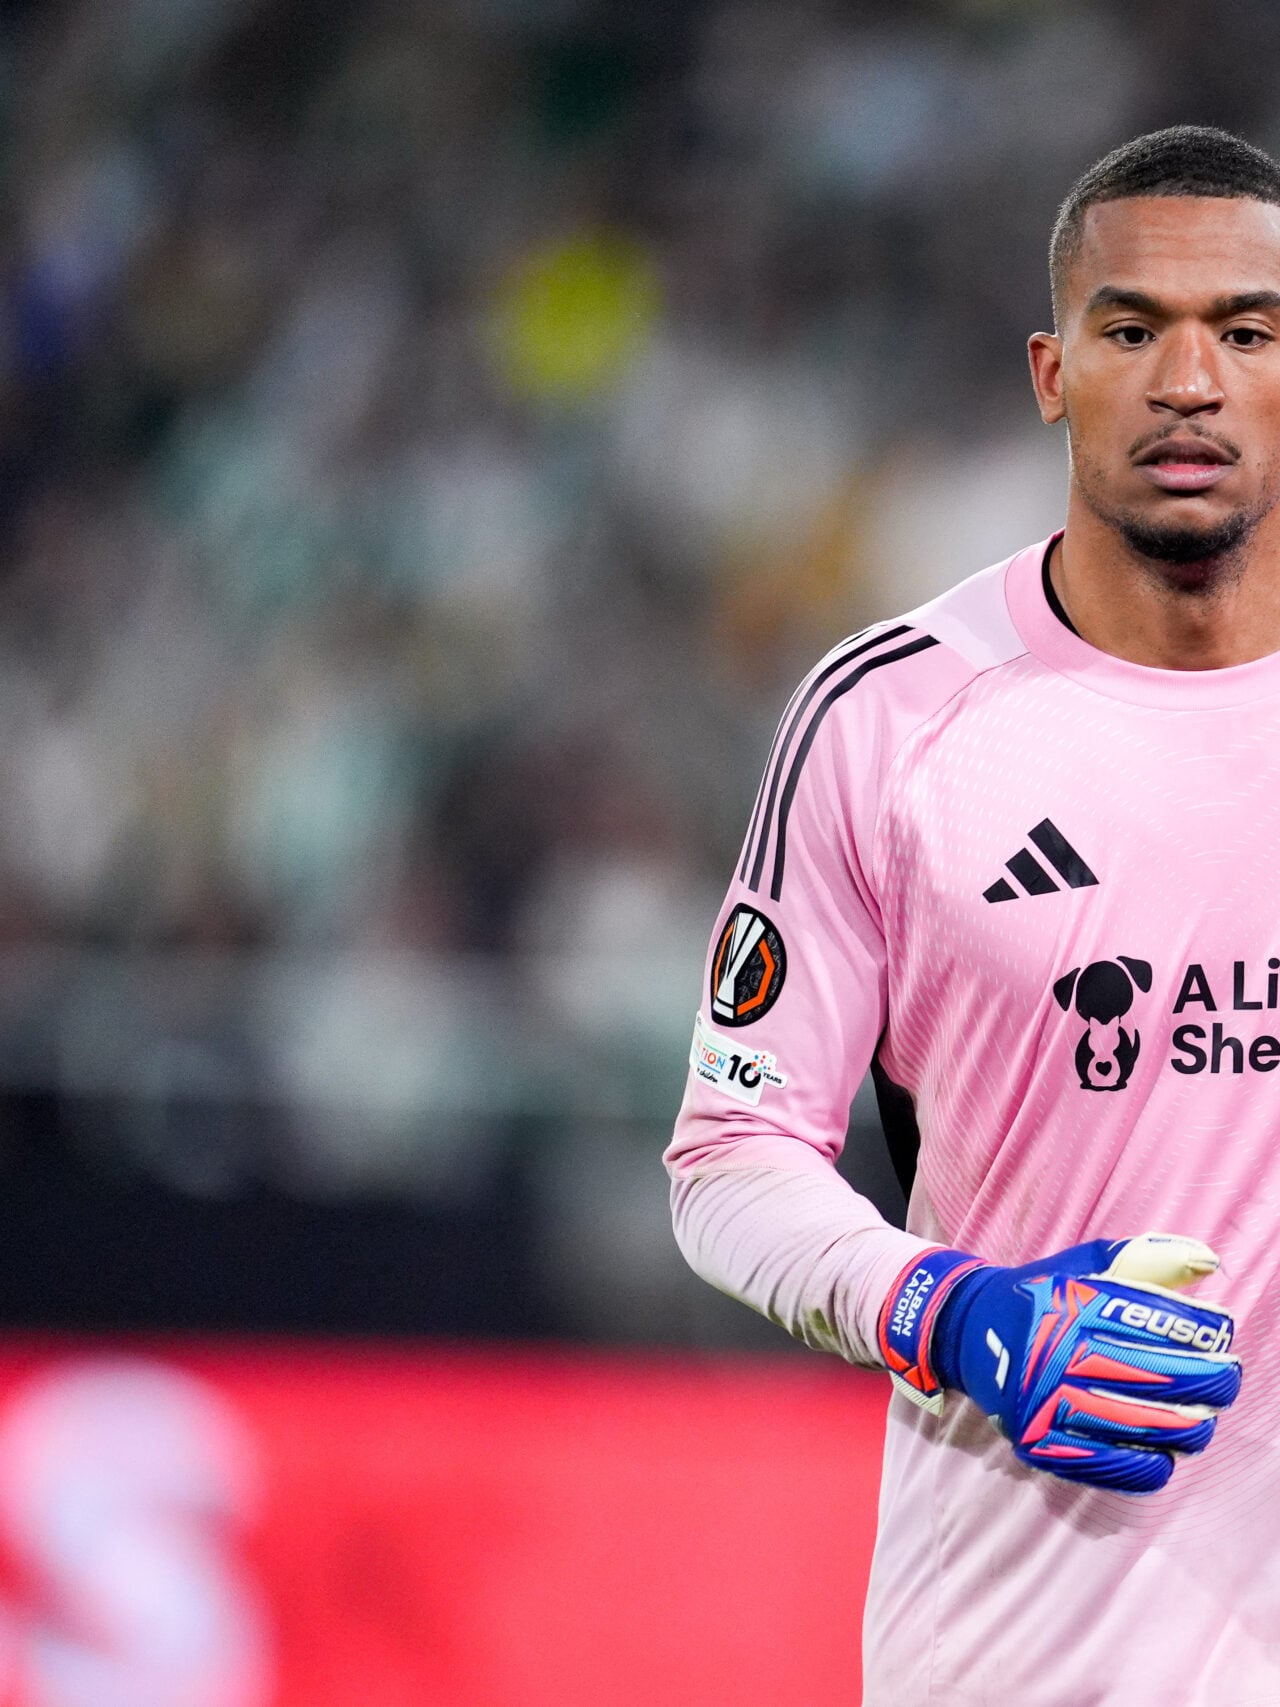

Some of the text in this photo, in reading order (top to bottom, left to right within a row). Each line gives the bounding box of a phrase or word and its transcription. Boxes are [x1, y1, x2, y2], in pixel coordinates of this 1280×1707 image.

[1172, 963, 1218, 1014] A
[727, 1054, 762, 1088] 10
[762, 1072, 783, 1085] YEARS
[891, 1268, 928, 1336] LAFONT
[902, 1272, 935, 1337] ALBAN
[1100, 1297, 1233, 1353] reusch
